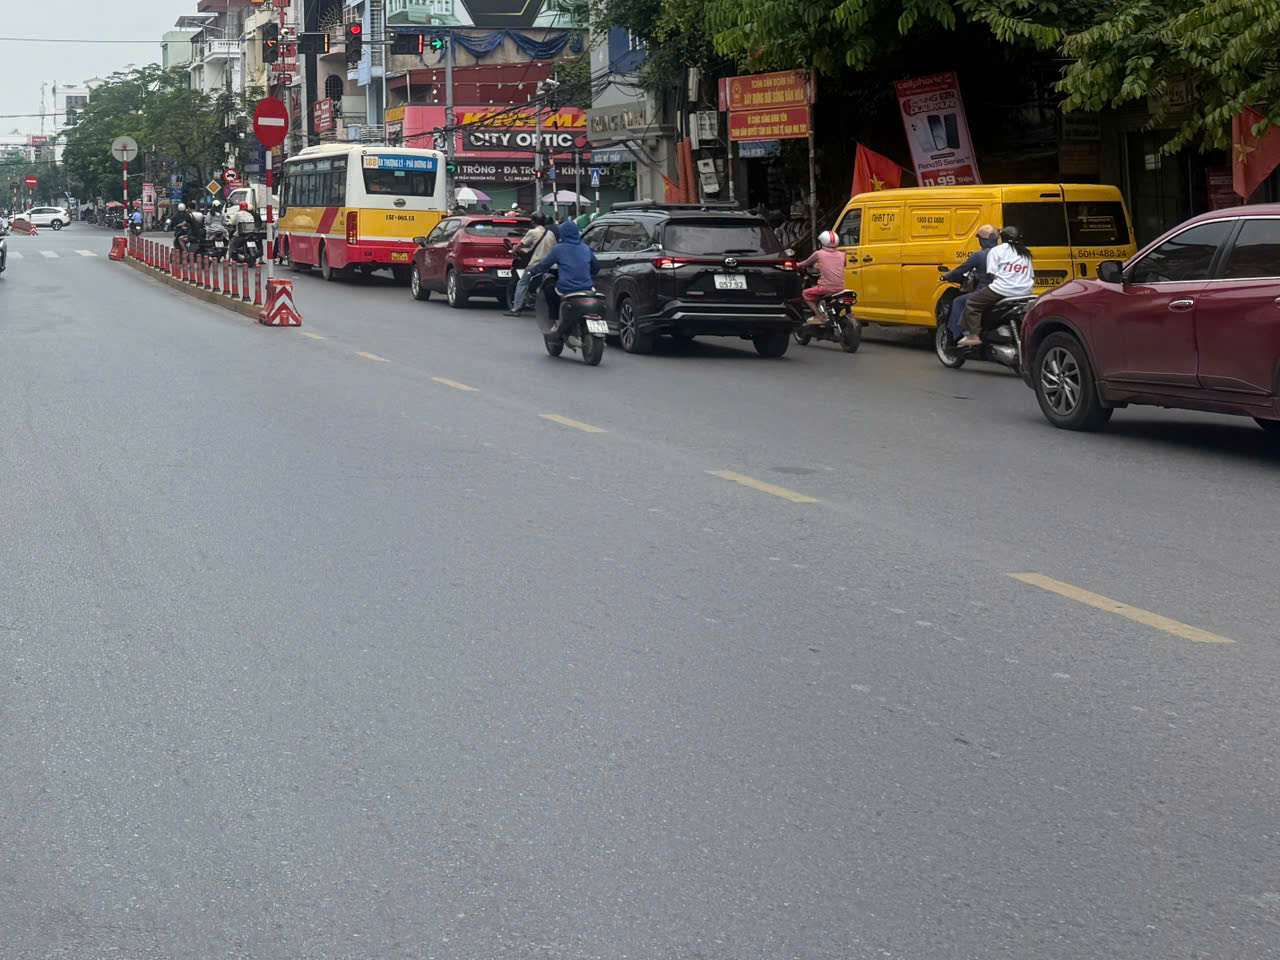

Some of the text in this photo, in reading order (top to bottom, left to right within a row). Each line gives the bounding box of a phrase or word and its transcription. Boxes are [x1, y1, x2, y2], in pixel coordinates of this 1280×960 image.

[470, 132, 573, 147] CITY OPTIC
[463, 164, 496, 174] TRÒNG
[504, 165, 518, 174] ĐA
